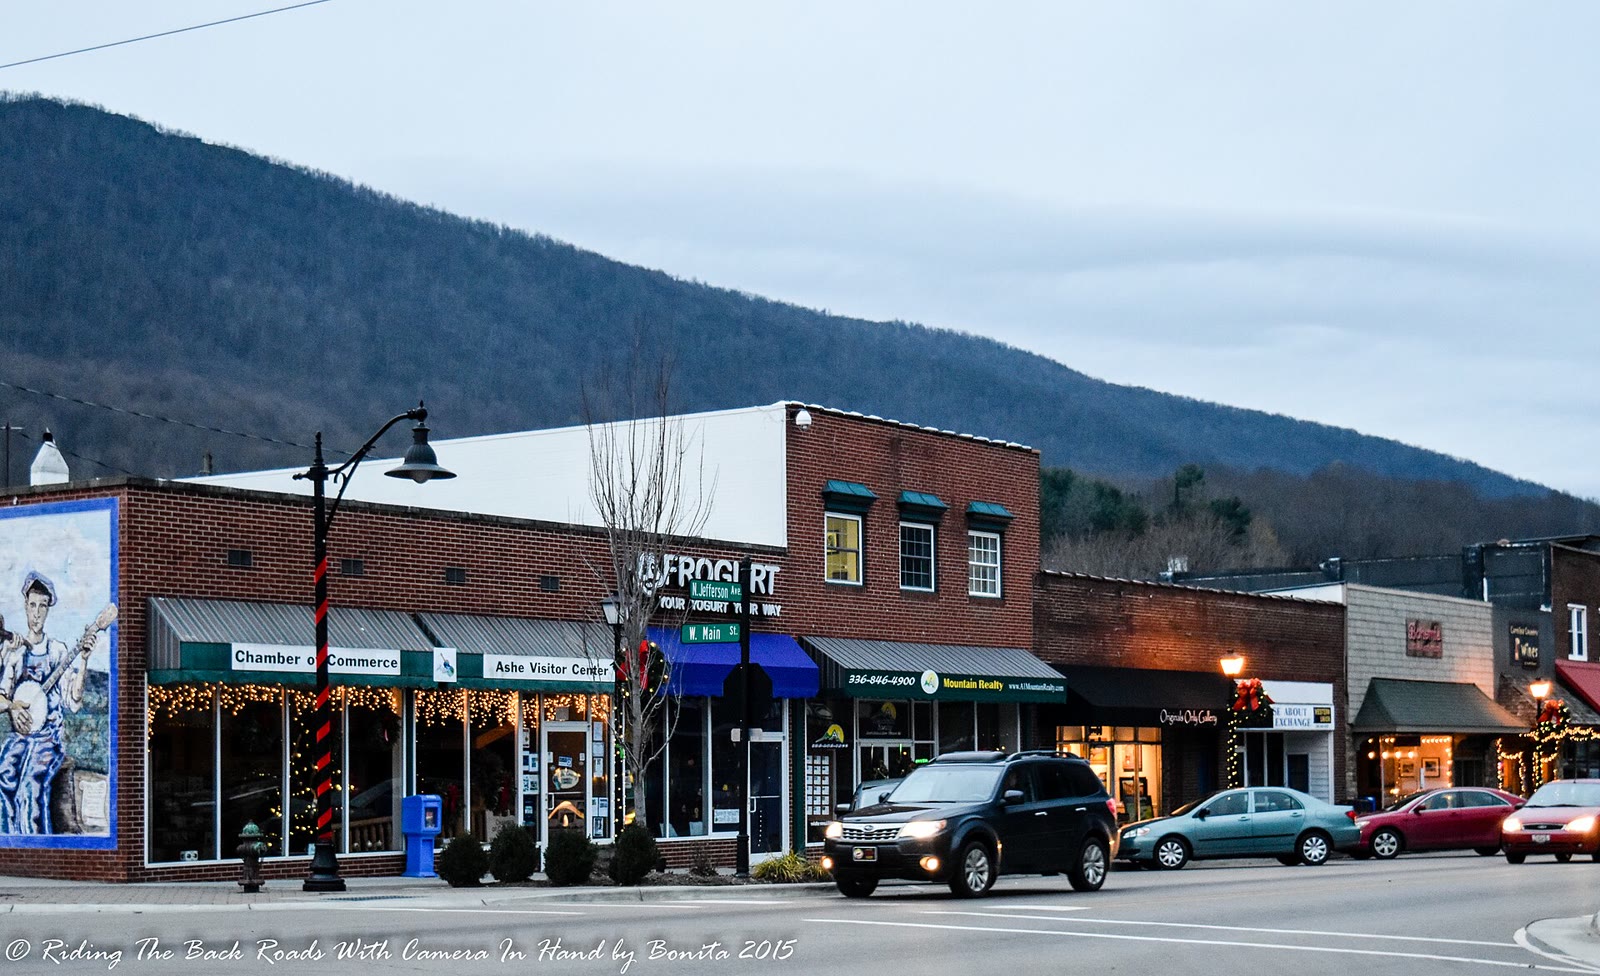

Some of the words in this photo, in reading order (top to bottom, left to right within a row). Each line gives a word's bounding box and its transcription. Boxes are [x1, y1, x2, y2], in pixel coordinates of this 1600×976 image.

[659, 596, 685, 610] YOUR
[691, 600, 729, 614] YOGURT
[762, 603, 782, 617] WAY
[689, 626, 698, 641] W.
[702, 626, 721, 641] Main
[729, 626, 739, 636] St.
[235, 650, 301, 665] Chamber
[327, 653, 398, 669] Commerce
[495, 661, 525, 673] Ashe
[530, 662, 568, 675] Visitor
[571, 664, 609, 676] Center
[848, 674, 916, 687] 336-846-4900
[943, 678, 977, 690] Mountain
[978, 680, 1004, 692] Realty
[1160, 708, 1184, 726] Originals
[1184, 709, 1198, 727] Only
[1198, 709, 1218, 727] Gallery
[1284, 707, 1307, 716] ABOUT
[1274, 717, 1311, 727] EXCHANGE
